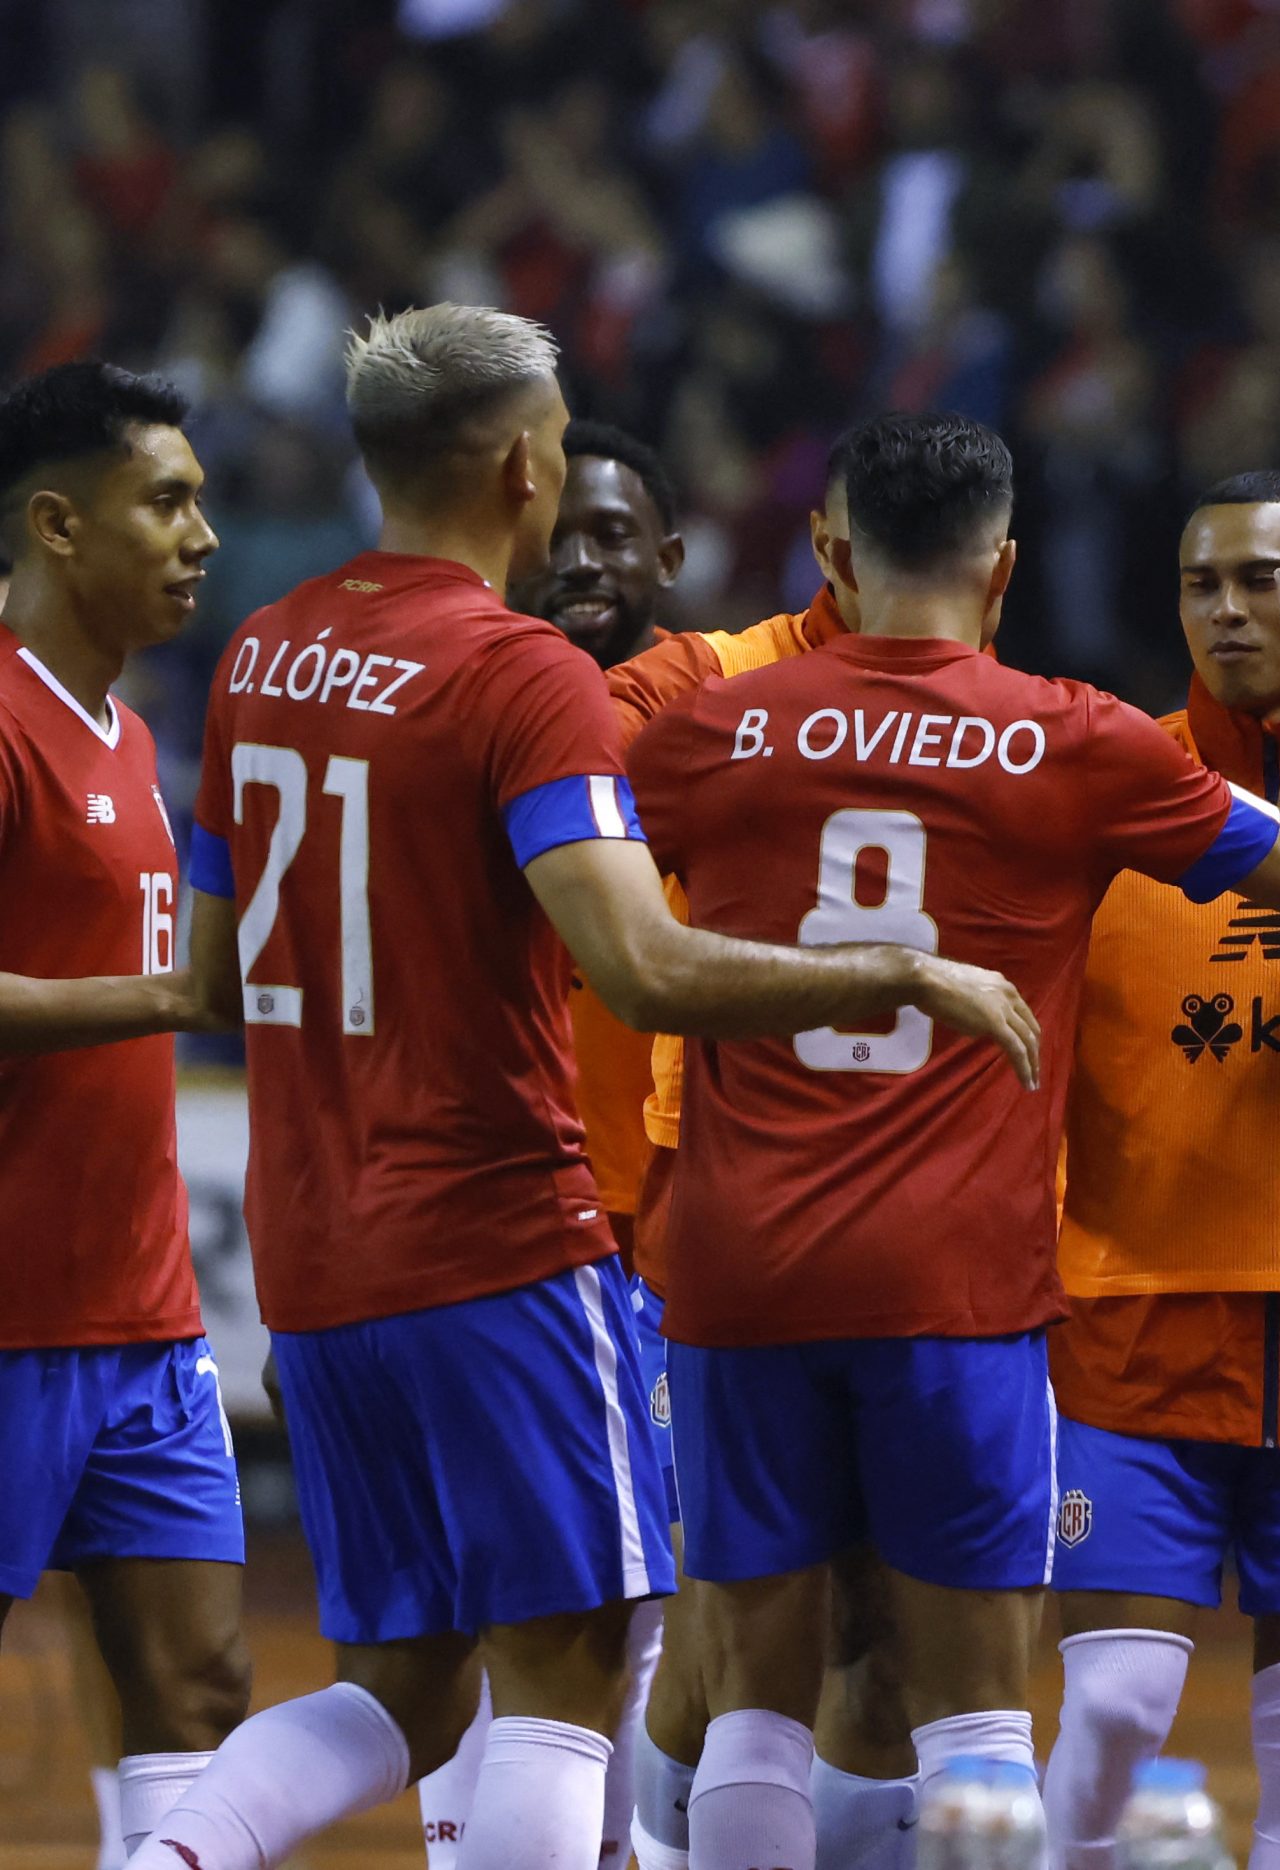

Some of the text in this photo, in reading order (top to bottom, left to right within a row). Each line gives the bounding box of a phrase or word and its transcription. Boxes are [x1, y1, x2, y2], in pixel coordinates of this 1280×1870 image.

[731, 708, 1046, 775] B. OVIEDO
[139, 872, 173, 976] 16
[231, 743, 374, 1035] 21
[793, 808, 938, 1074] 8
[425, 1820, 466, 1842] CR
